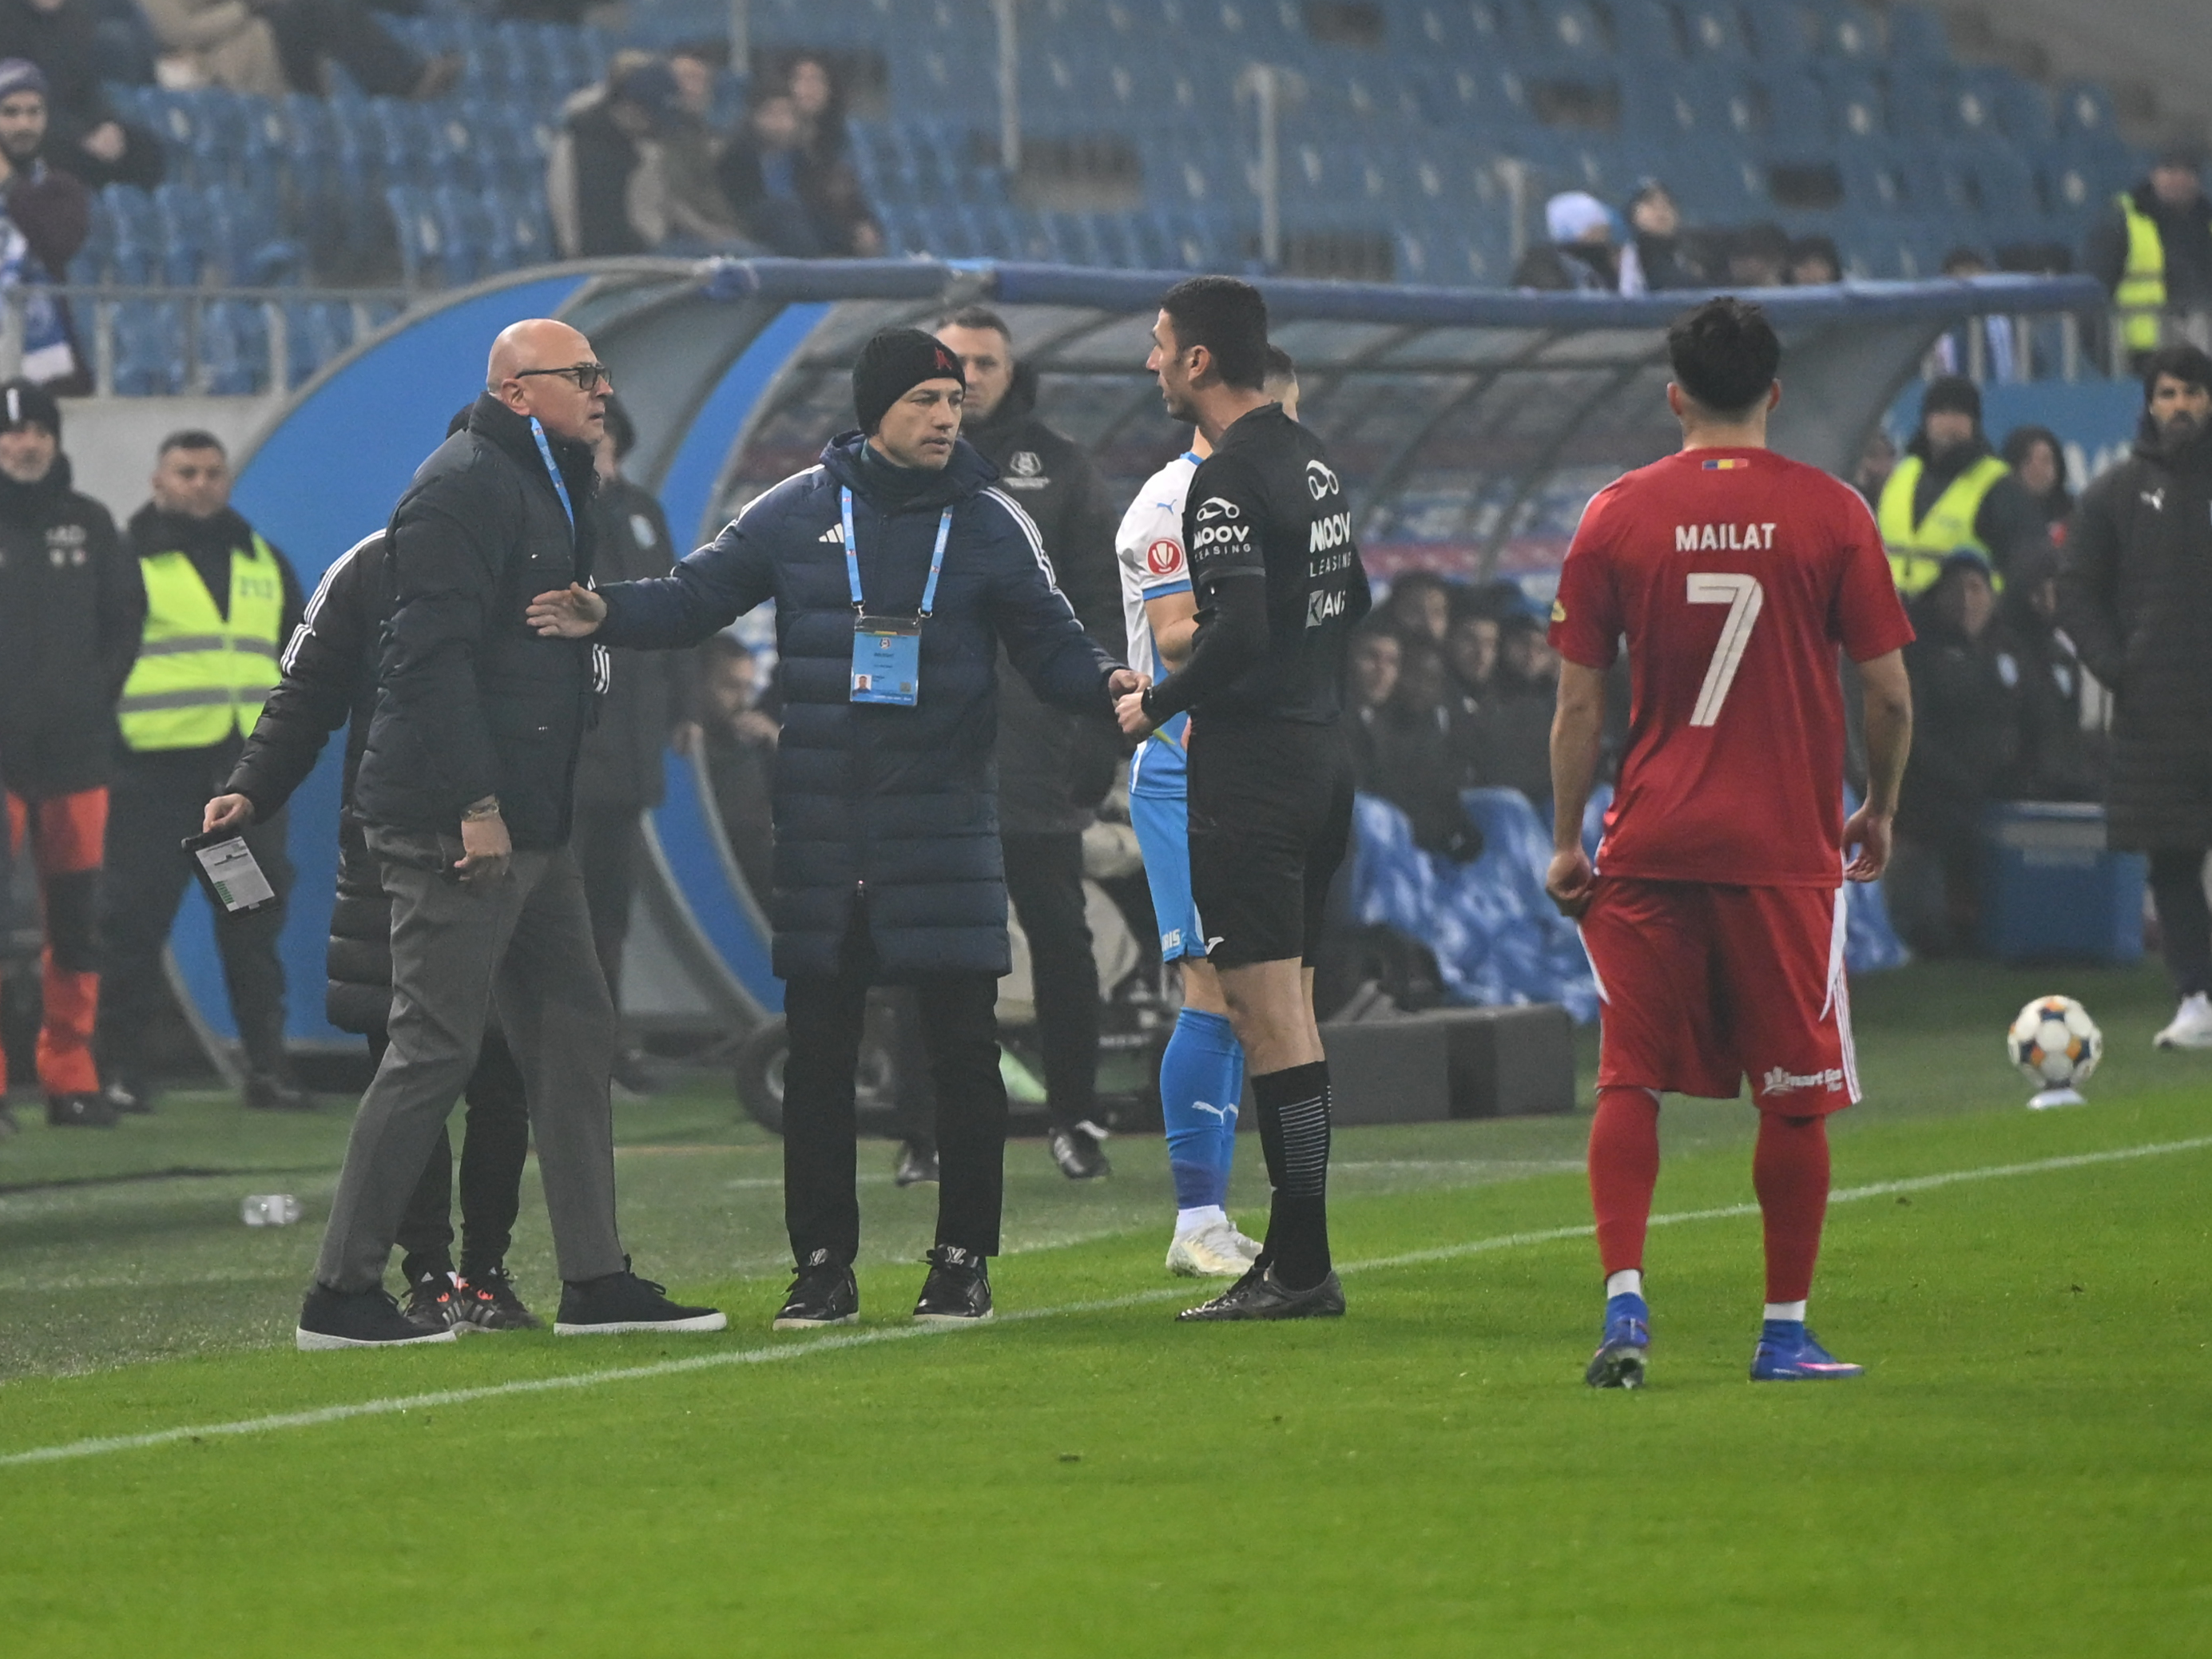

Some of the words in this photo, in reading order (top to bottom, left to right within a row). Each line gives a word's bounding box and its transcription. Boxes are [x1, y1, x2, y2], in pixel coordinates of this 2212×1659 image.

[1193, 525, 1250, 550] MOOV
[1309, 511, 1351, 554] MOOV
[1675, 523, 1776, 551] MAILAT
[1686, 573, 1764, 726] 7
